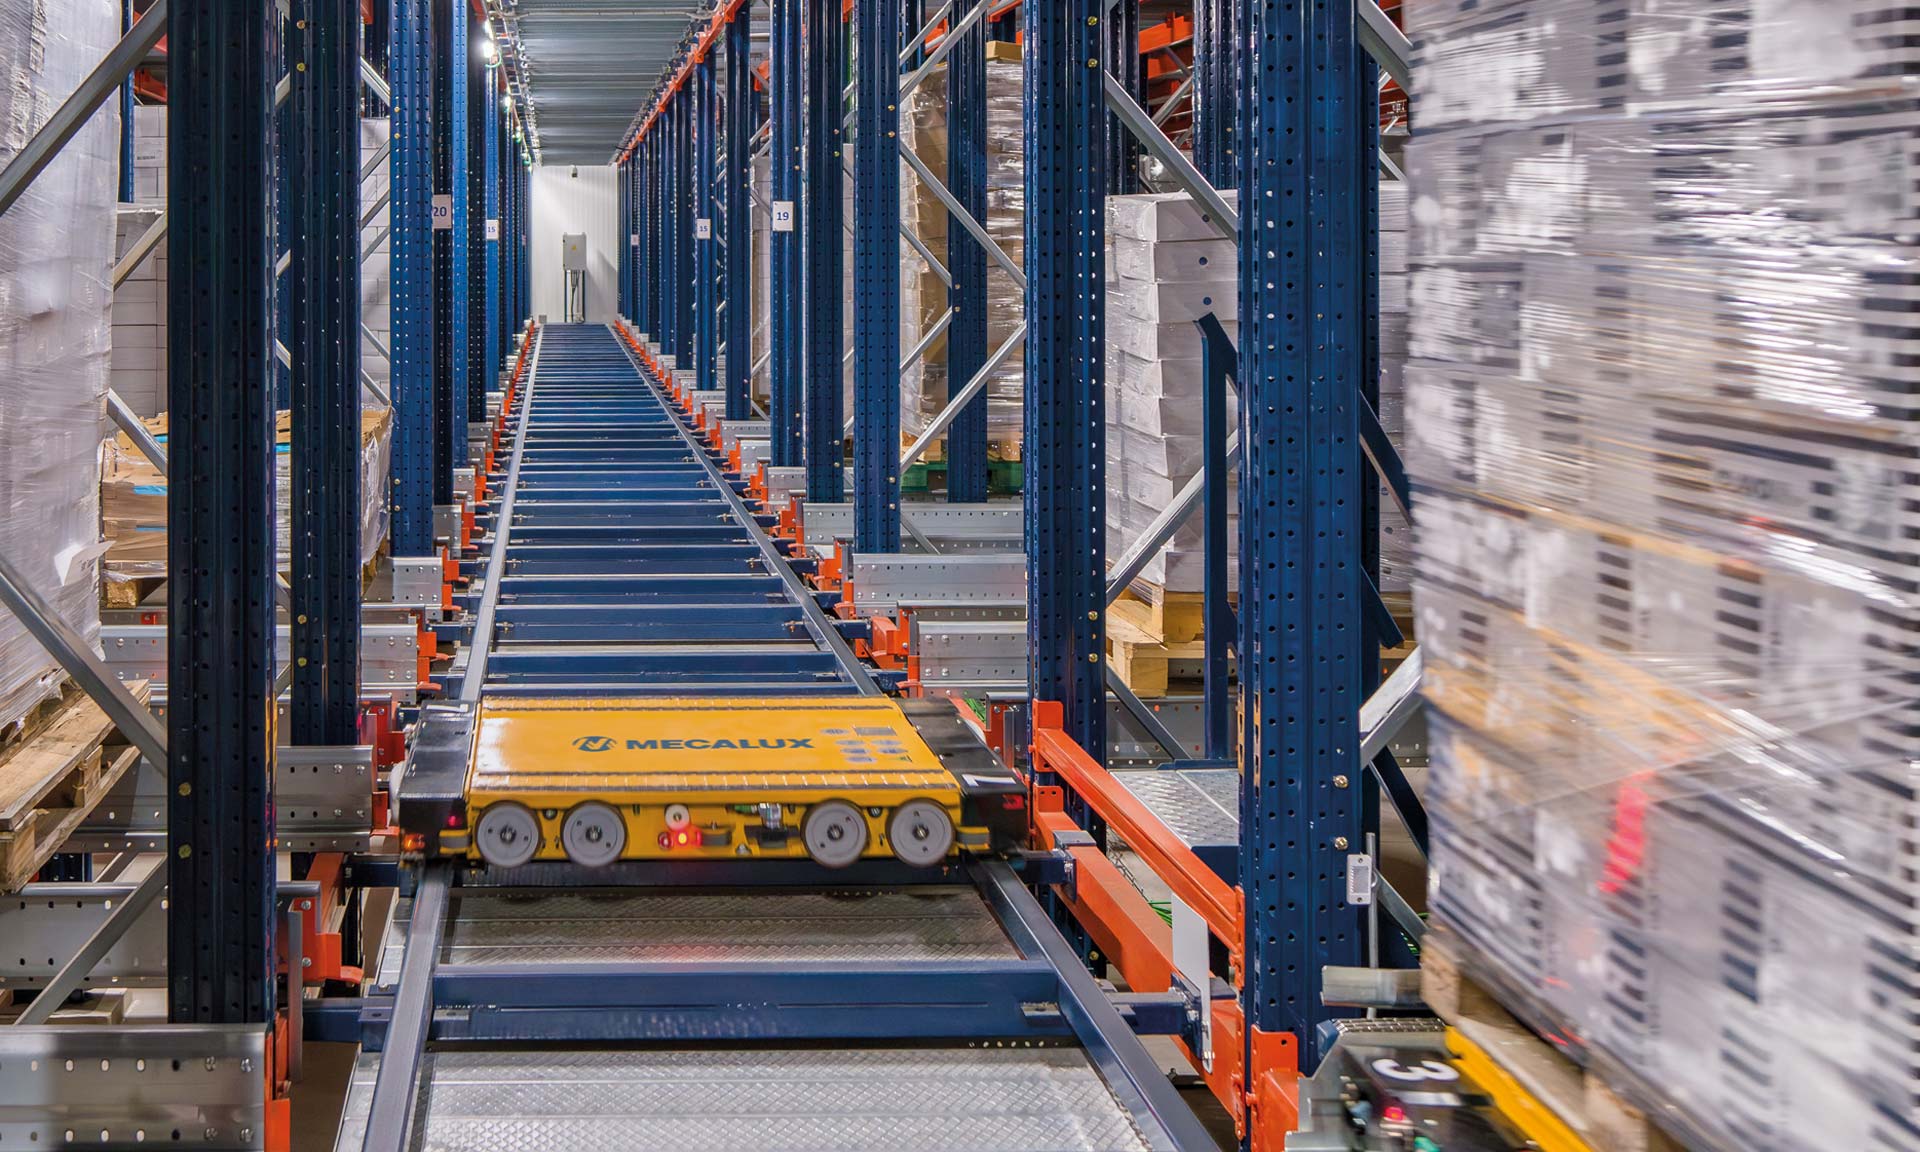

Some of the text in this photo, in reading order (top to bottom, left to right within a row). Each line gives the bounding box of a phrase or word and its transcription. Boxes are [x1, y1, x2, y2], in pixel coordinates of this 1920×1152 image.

[433, 206, 447, 217] 20
[776, 211, 789, 221] 19
[626, 738, 815, 750] MECALUX
[1371, 1058, 1460, 1081] 3
